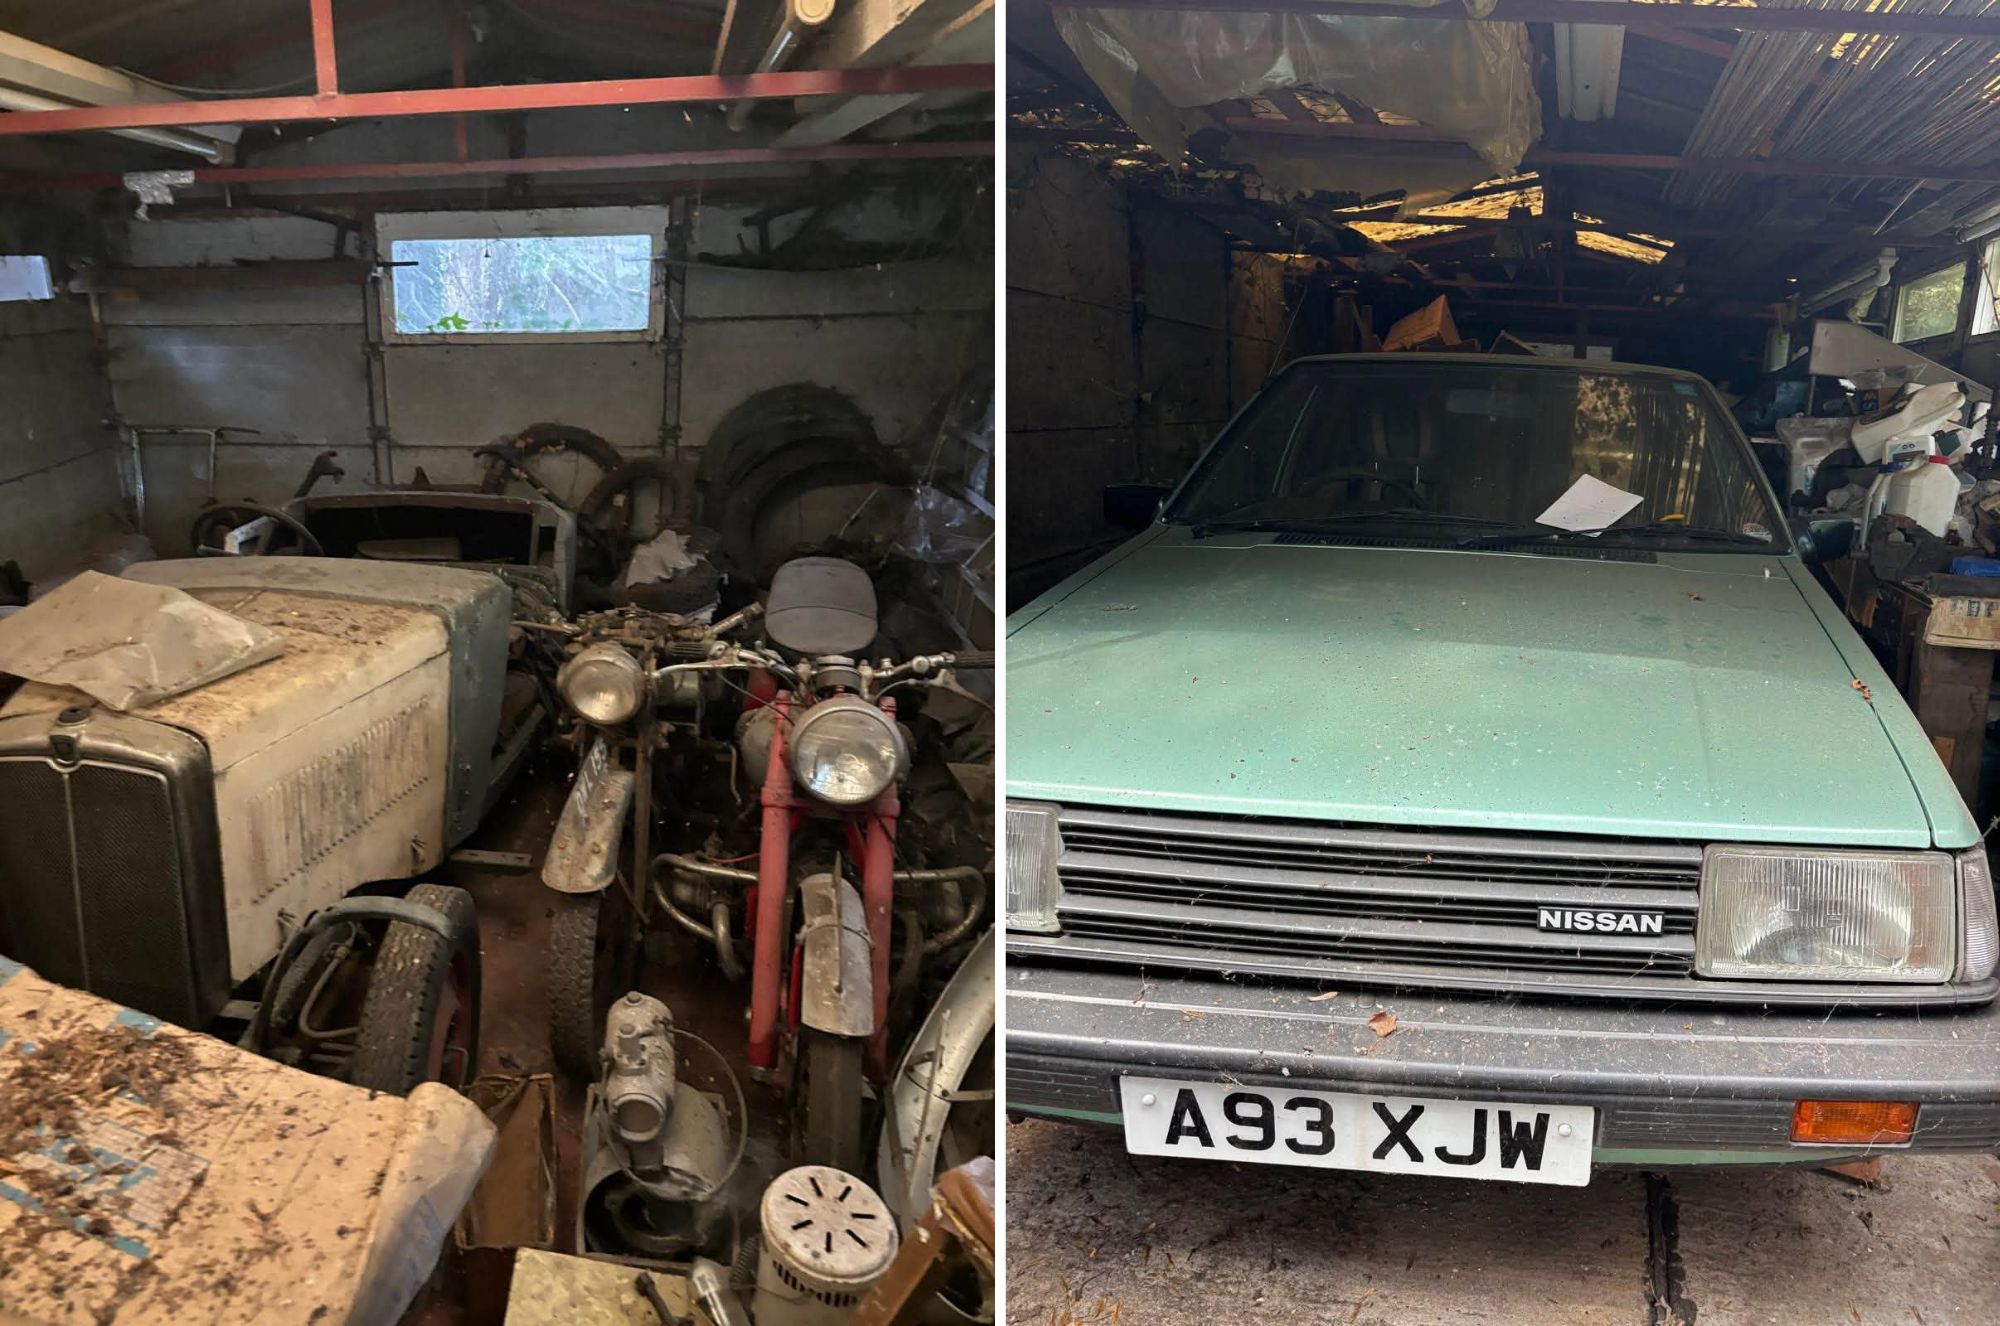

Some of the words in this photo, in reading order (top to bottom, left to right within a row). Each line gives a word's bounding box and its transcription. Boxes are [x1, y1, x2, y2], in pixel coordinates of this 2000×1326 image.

[1539, 909, 1663, 933] NISSAN
[1165, 1088, 1336, 1156] A93
[1372, 1102, 1551, 1171] XJW
